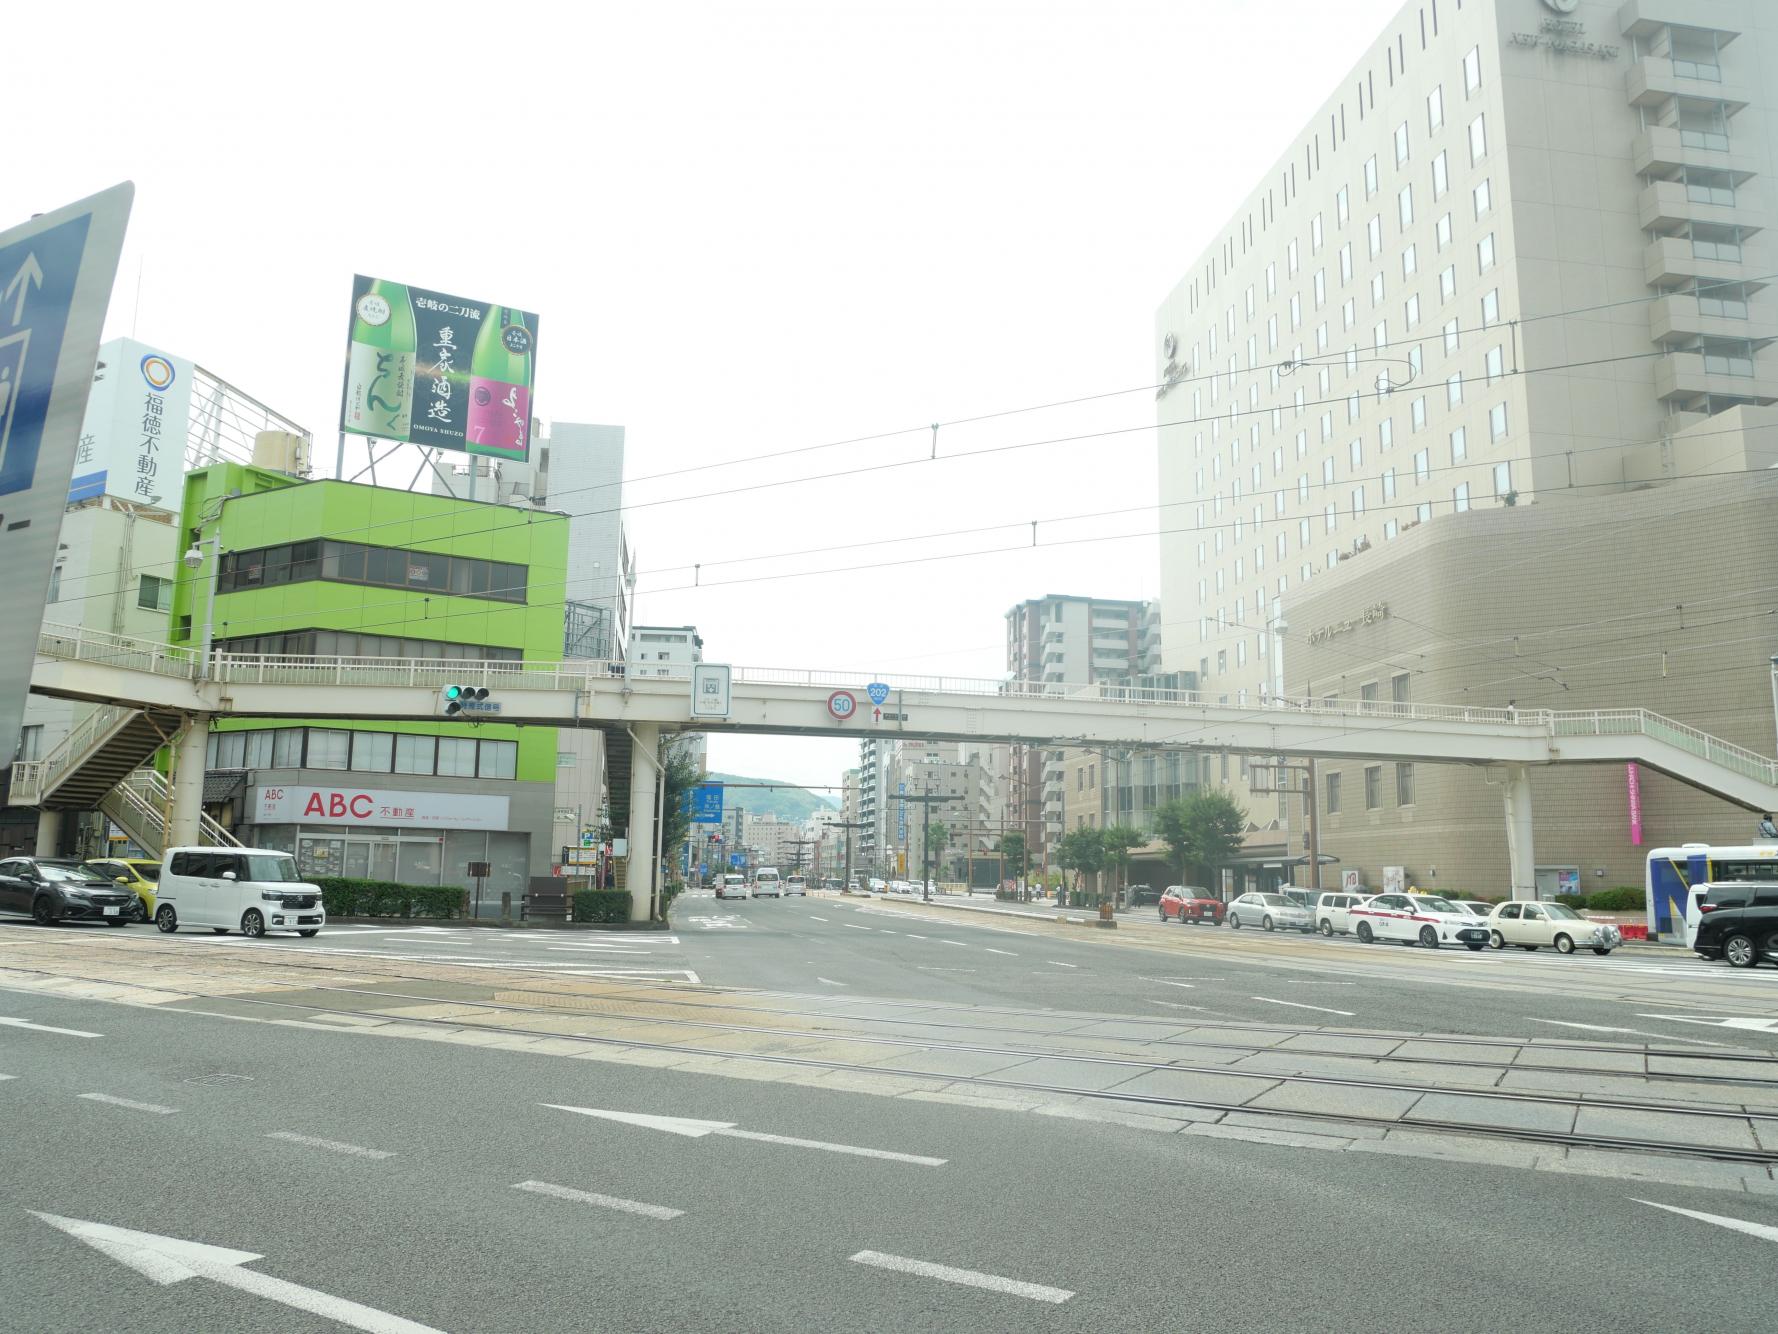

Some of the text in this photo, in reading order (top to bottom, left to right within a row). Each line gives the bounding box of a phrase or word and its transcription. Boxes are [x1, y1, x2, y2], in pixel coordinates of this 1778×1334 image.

[416, 297, 481, 320] 壱岐の二刀流
[440, 427, 464, 437] SHUZO
[135, 392, 165, 496] 福徳不動産
[870, 688, 887, 697] 202
[833, 698, 850, 711] 50
[264, 789, 284, 800] ABC
[303, 792, 374, 819] ABC
[379, 806, 416, 818] 不動産
